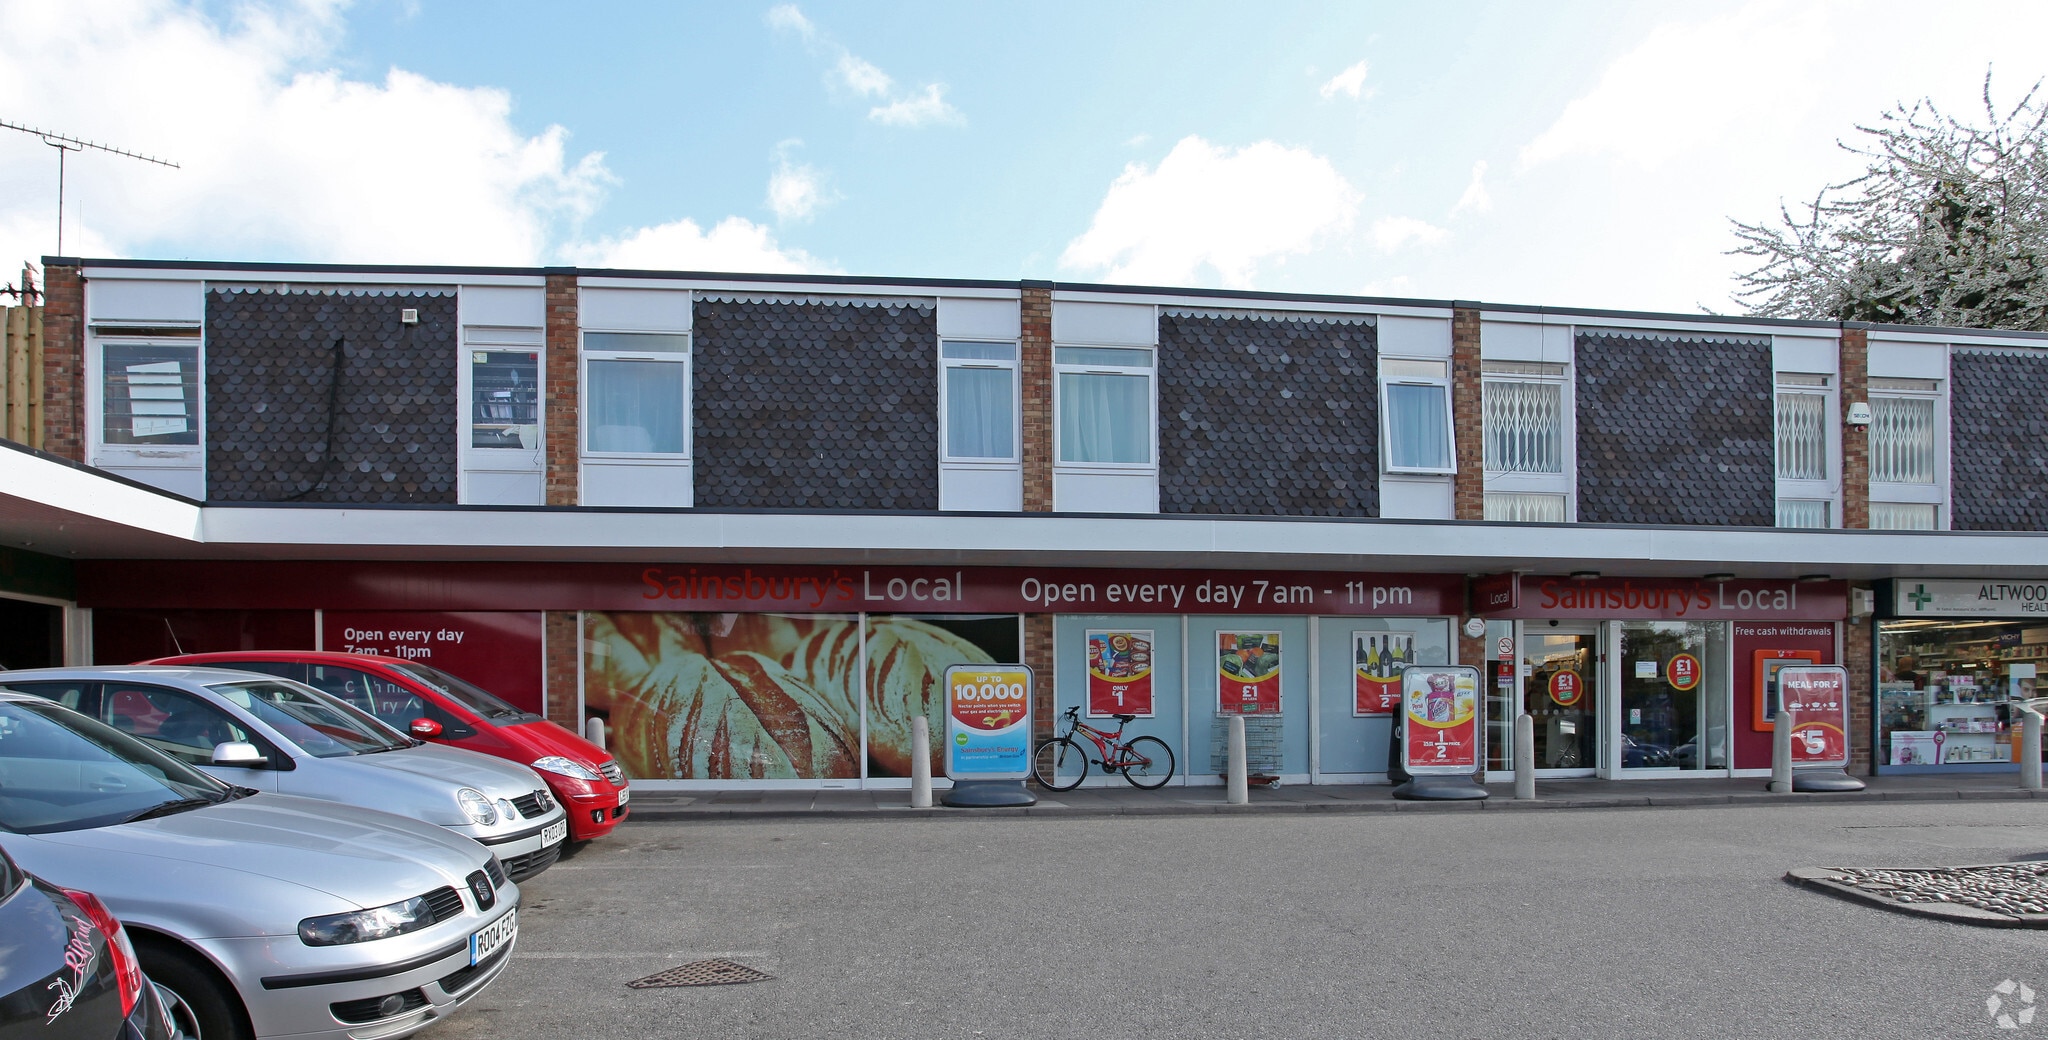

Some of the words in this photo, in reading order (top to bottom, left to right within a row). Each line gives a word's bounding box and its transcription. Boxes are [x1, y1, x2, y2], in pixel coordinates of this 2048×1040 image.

[642, 568, 855, 608] Sainsbury's
[864, 571, 962, 601] Local
[1021, 577, 1096, 607] Open
[1106, 584, 1185, 608] every
[1196, 580, 1245, 608] day
[1978, 585, 2047, 601] ALTWOO
[1490, 590, 1510, 605] Local
[1540, 580, 1712, 616] Sainsbury's
[1719, 583, 1797, 610] Local
[344, 628, 383, 642] Open
[388, 631, 431, 643] every
[437, 628, 464, 643] day
[1735, 627, 1754, 636] Free
[1757, 627, 1777, 636] cash
[1780, 627, 1831, 636] withdrawals
[2001, 633, 2020, 641] VICHY
[344, 645, 378, 656] 7am
[395, 645, 431, 660] 11pm
[1676, 659, 1691, 672] £1
[1558, 674, 1573, 687] £1
[954, 683, 1024, 701] 10,000
[1242, 685, 1257, 698] £1
[960, 745, 995, 754] Sainsbury's
[997, 745, 1018, 754] Energy
[1801, 730, 1825, 754] £5
